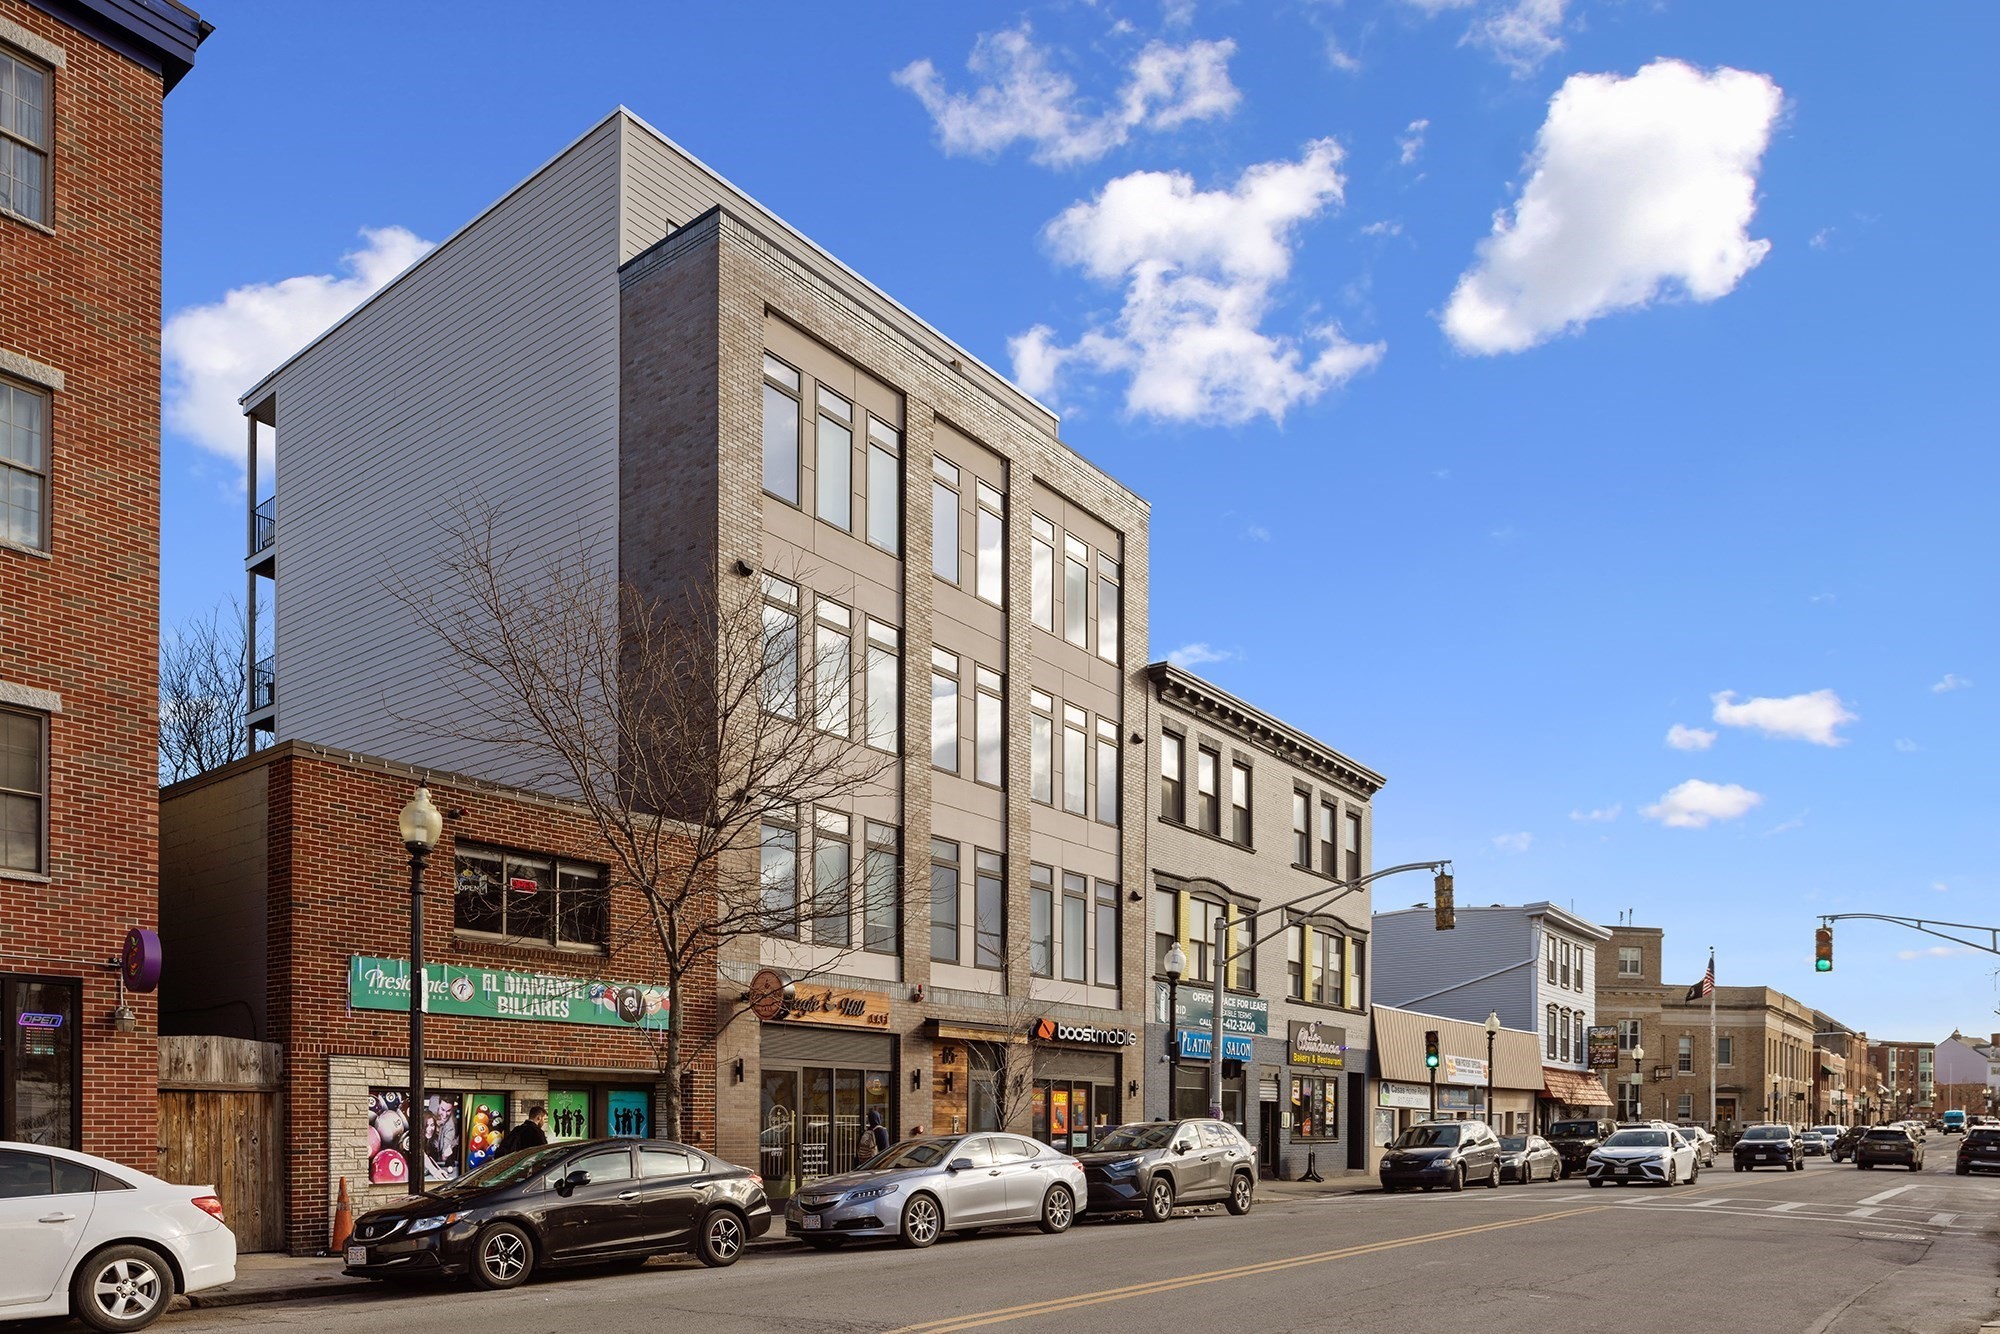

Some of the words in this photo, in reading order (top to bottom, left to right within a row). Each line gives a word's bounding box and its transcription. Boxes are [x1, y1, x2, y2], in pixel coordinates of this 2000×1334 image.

[364, 968, 449, 994] Presinte
[482, 973, 500, 993] EL
[505, 976, 585, 1000] DIAMANTE
[497, 995, 570, 1018] BILLARES
[1237, 999, 1249, 1009] FOR
[1249, 1000, 1268, 1012] LEASE
[22, 1015, 60, 1025] OPEN
[1222, 1020, 1256, 1033] -412-3240
[1181, 1031, 1212, 1055] PLATIN
[1226, 1040, 1251, 1056] SALON
[1293, 1052, 1310, 1064] Bakery
[1316, 1055, 1343, 1067] Restaurant
[1390, 1084, 1406, 1094] Casas
[1406, 1086, 1417, 1095] Home
